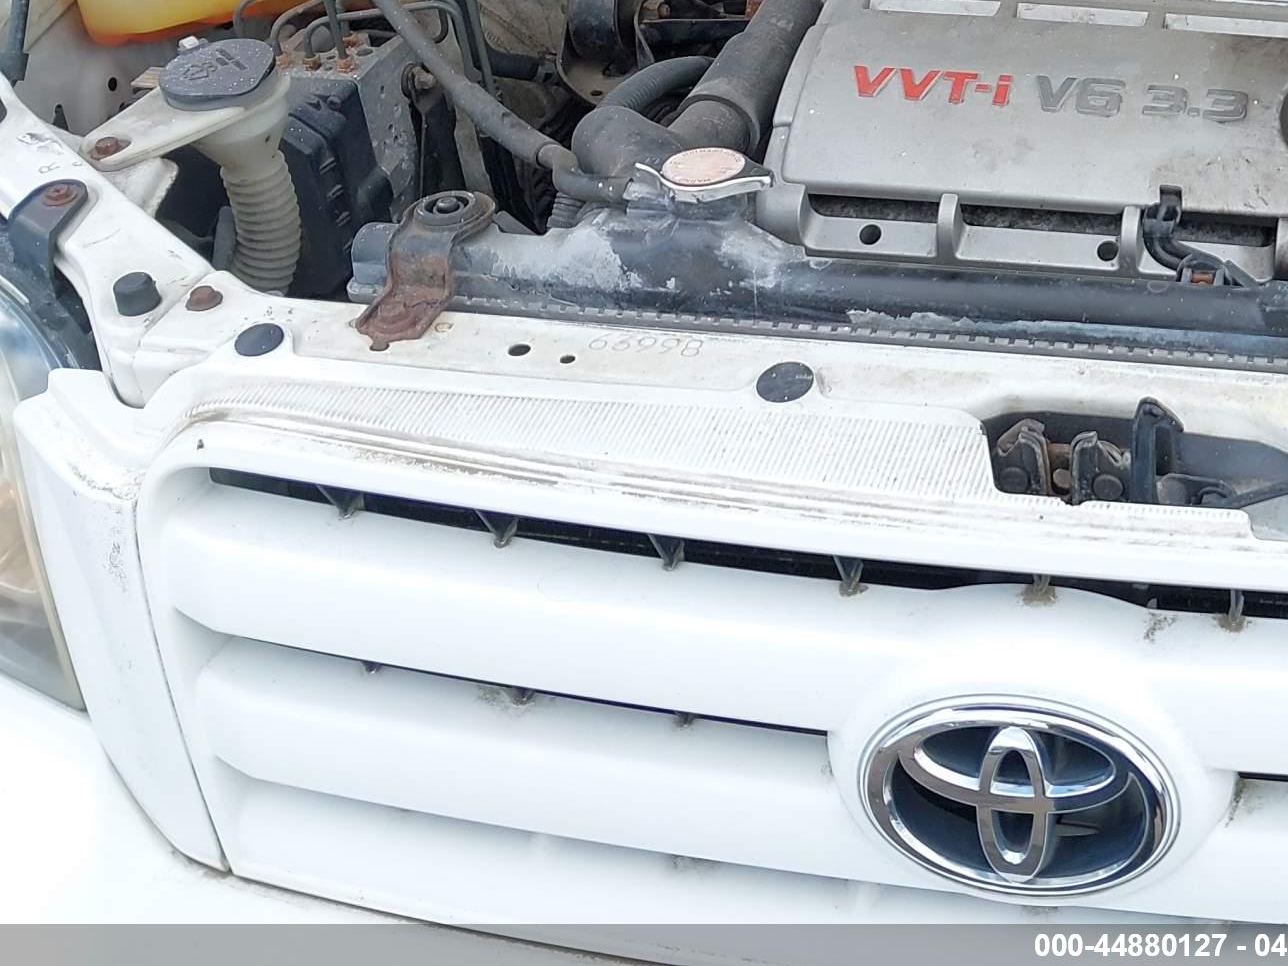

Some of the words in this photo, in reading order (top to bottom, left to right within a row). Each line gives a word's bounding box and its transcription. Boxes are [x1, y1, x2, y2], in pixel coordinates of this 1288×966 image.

[853, 65, 1014, 107] VVT-i
[1036, 75, 1127, 118] V6
[1141, 83, 1250, 123] 3.3
